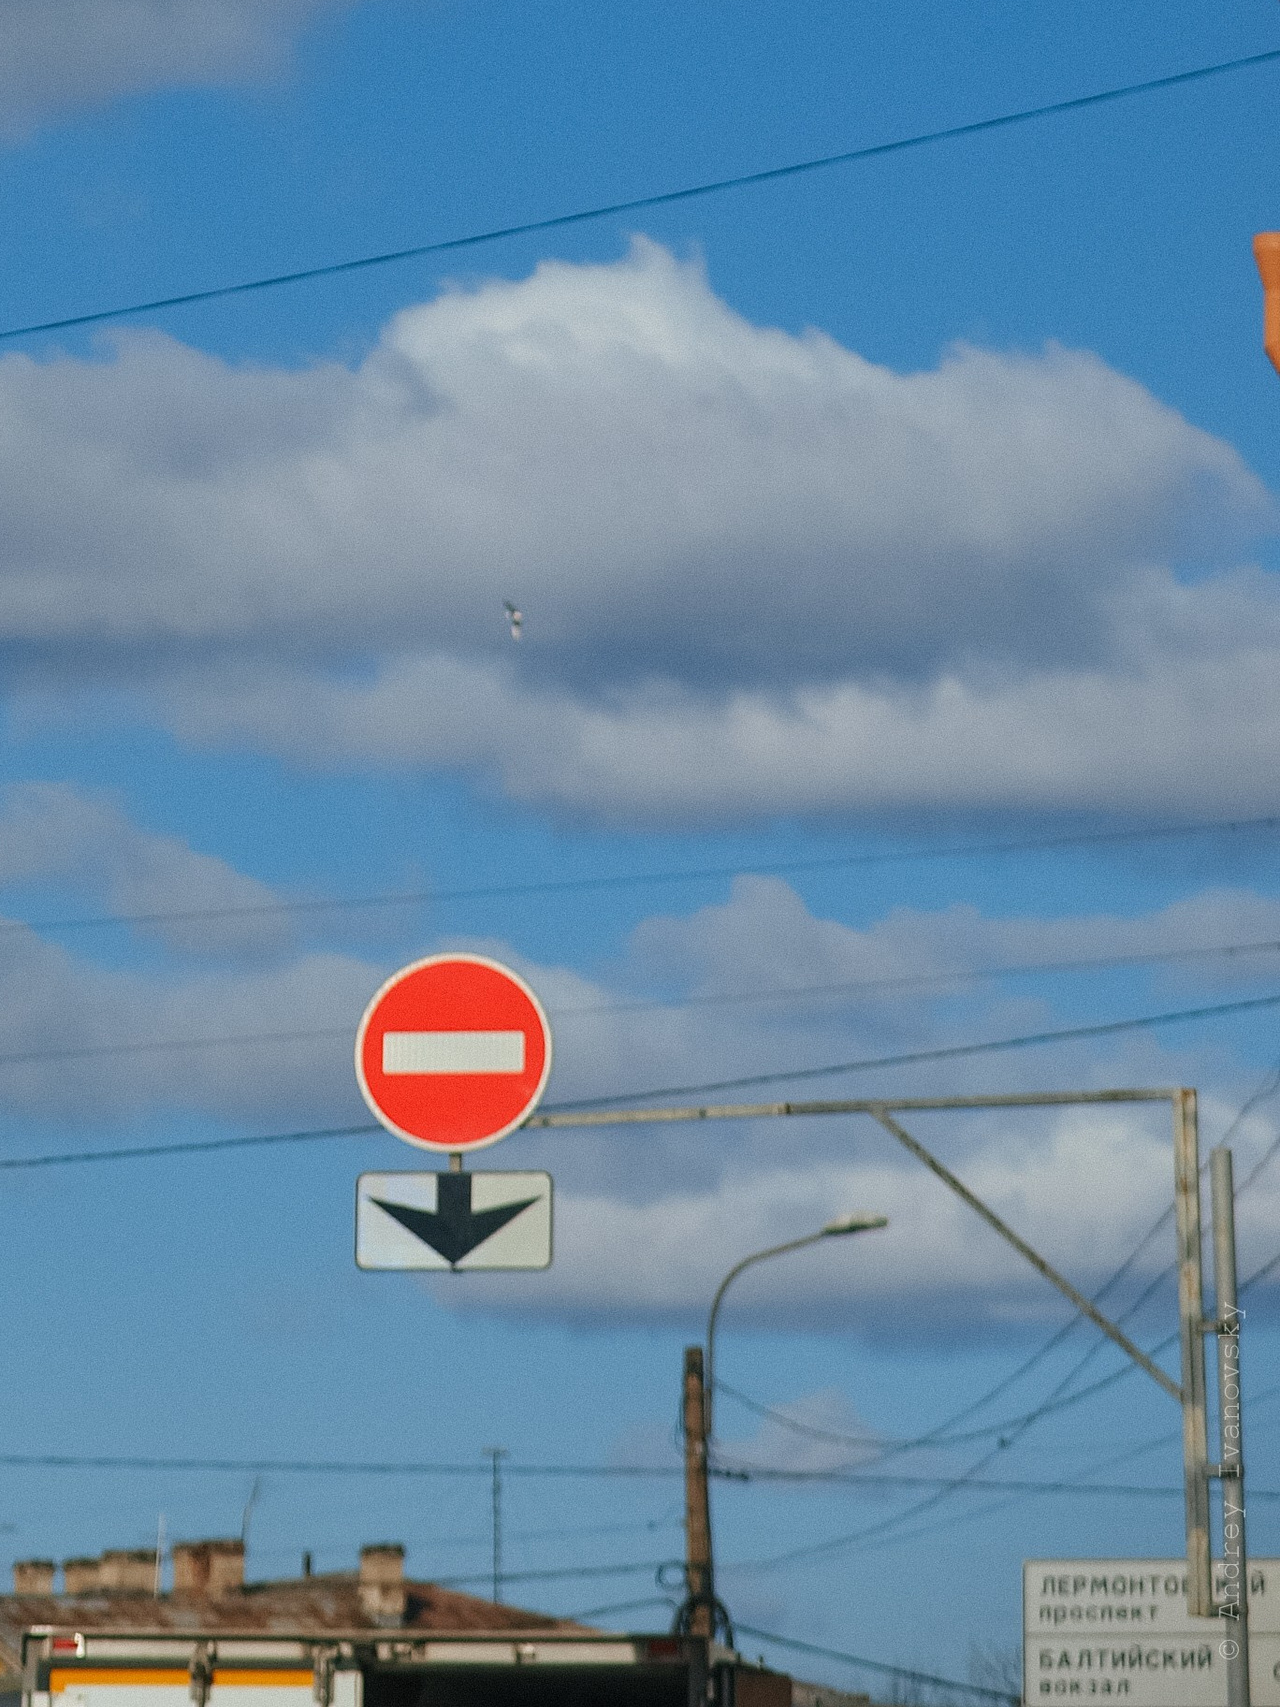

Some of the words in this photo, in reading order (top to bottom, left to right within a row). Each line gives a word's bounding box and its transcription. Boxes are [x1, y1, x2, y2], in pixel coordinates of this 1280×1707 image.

[1039, 1605, 1158, 1625] проспект
[1039, 1644, 1212, 1670] БАЛТИЙСКИЙ
[1039, 1678, 1130, 1696] вокзал
